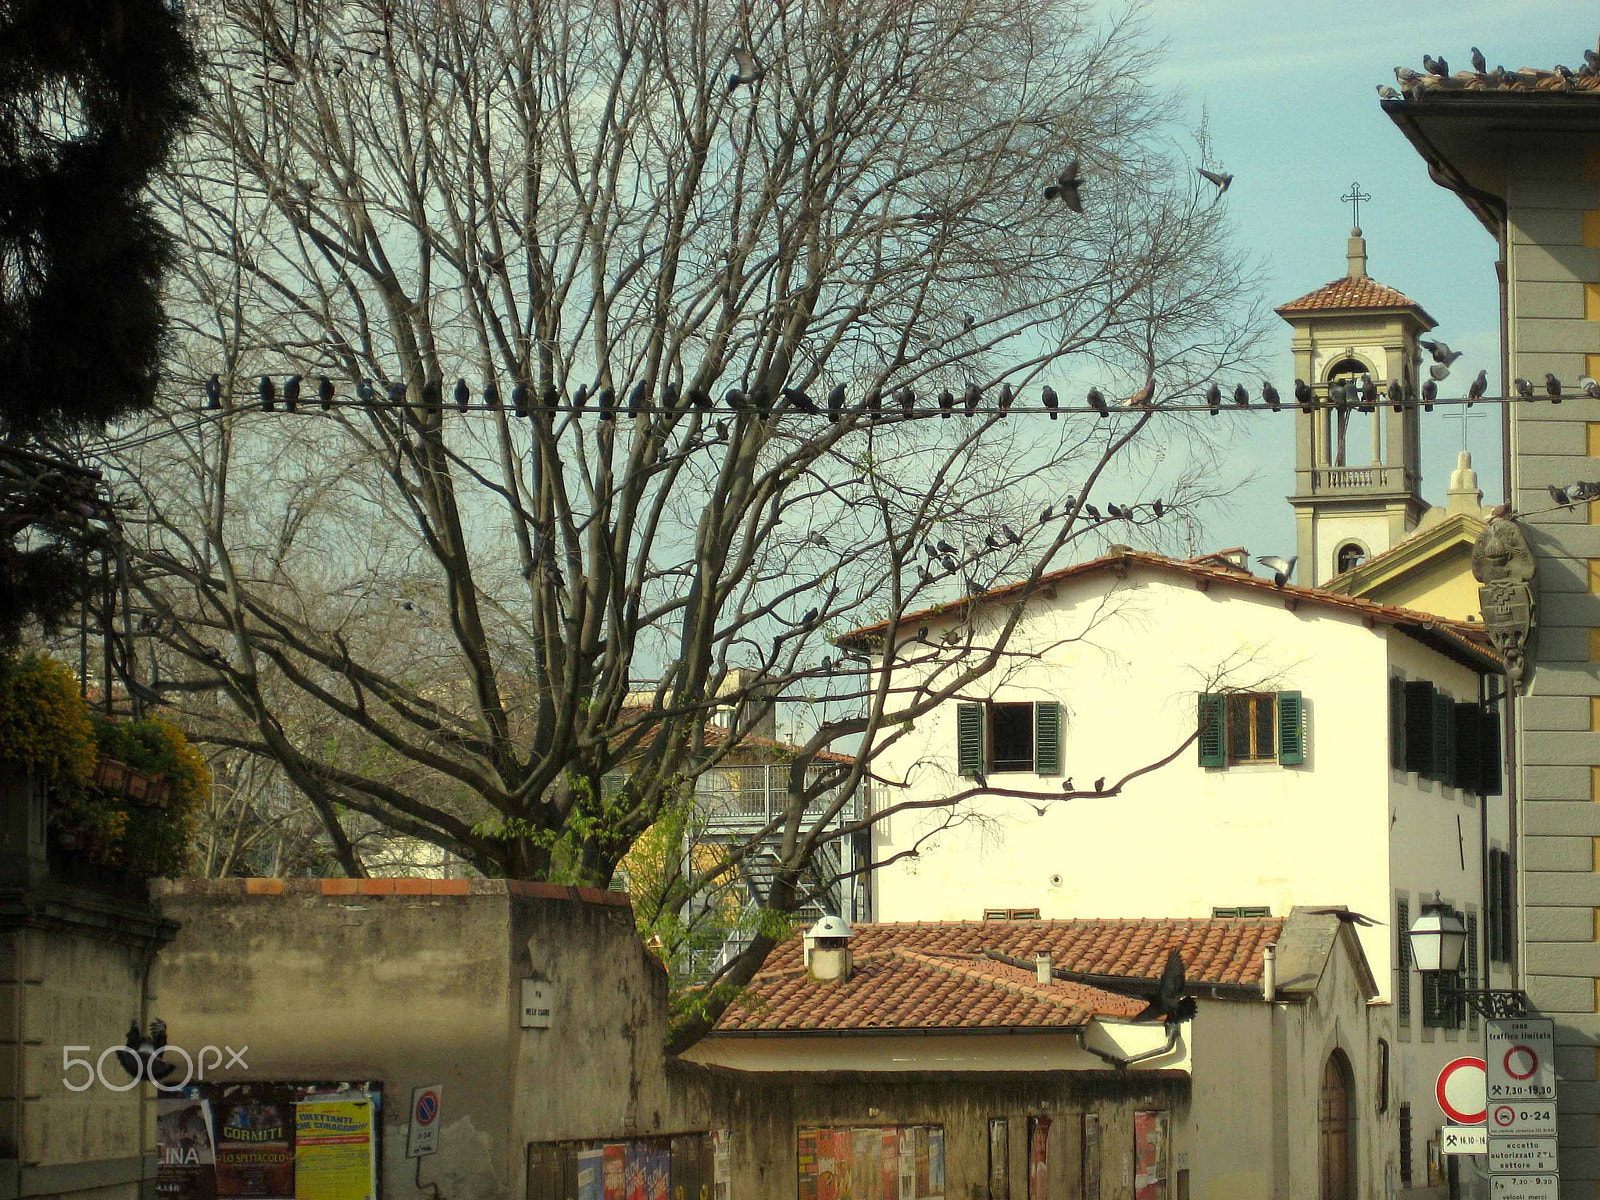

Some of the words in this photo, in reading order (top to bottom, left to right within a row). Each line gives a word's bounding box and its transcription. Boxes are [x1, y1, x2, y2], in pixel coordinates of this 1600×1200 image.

[1490, 1032, 1519, 1040] traffico
[1521, 1031, 1551, 1040] limitato
[223, 1126, 283, 1142] GORMITI
[1490, 1151, 1534, 1159] autorizzati
[1500, 1161, 1530, 1169] settore
